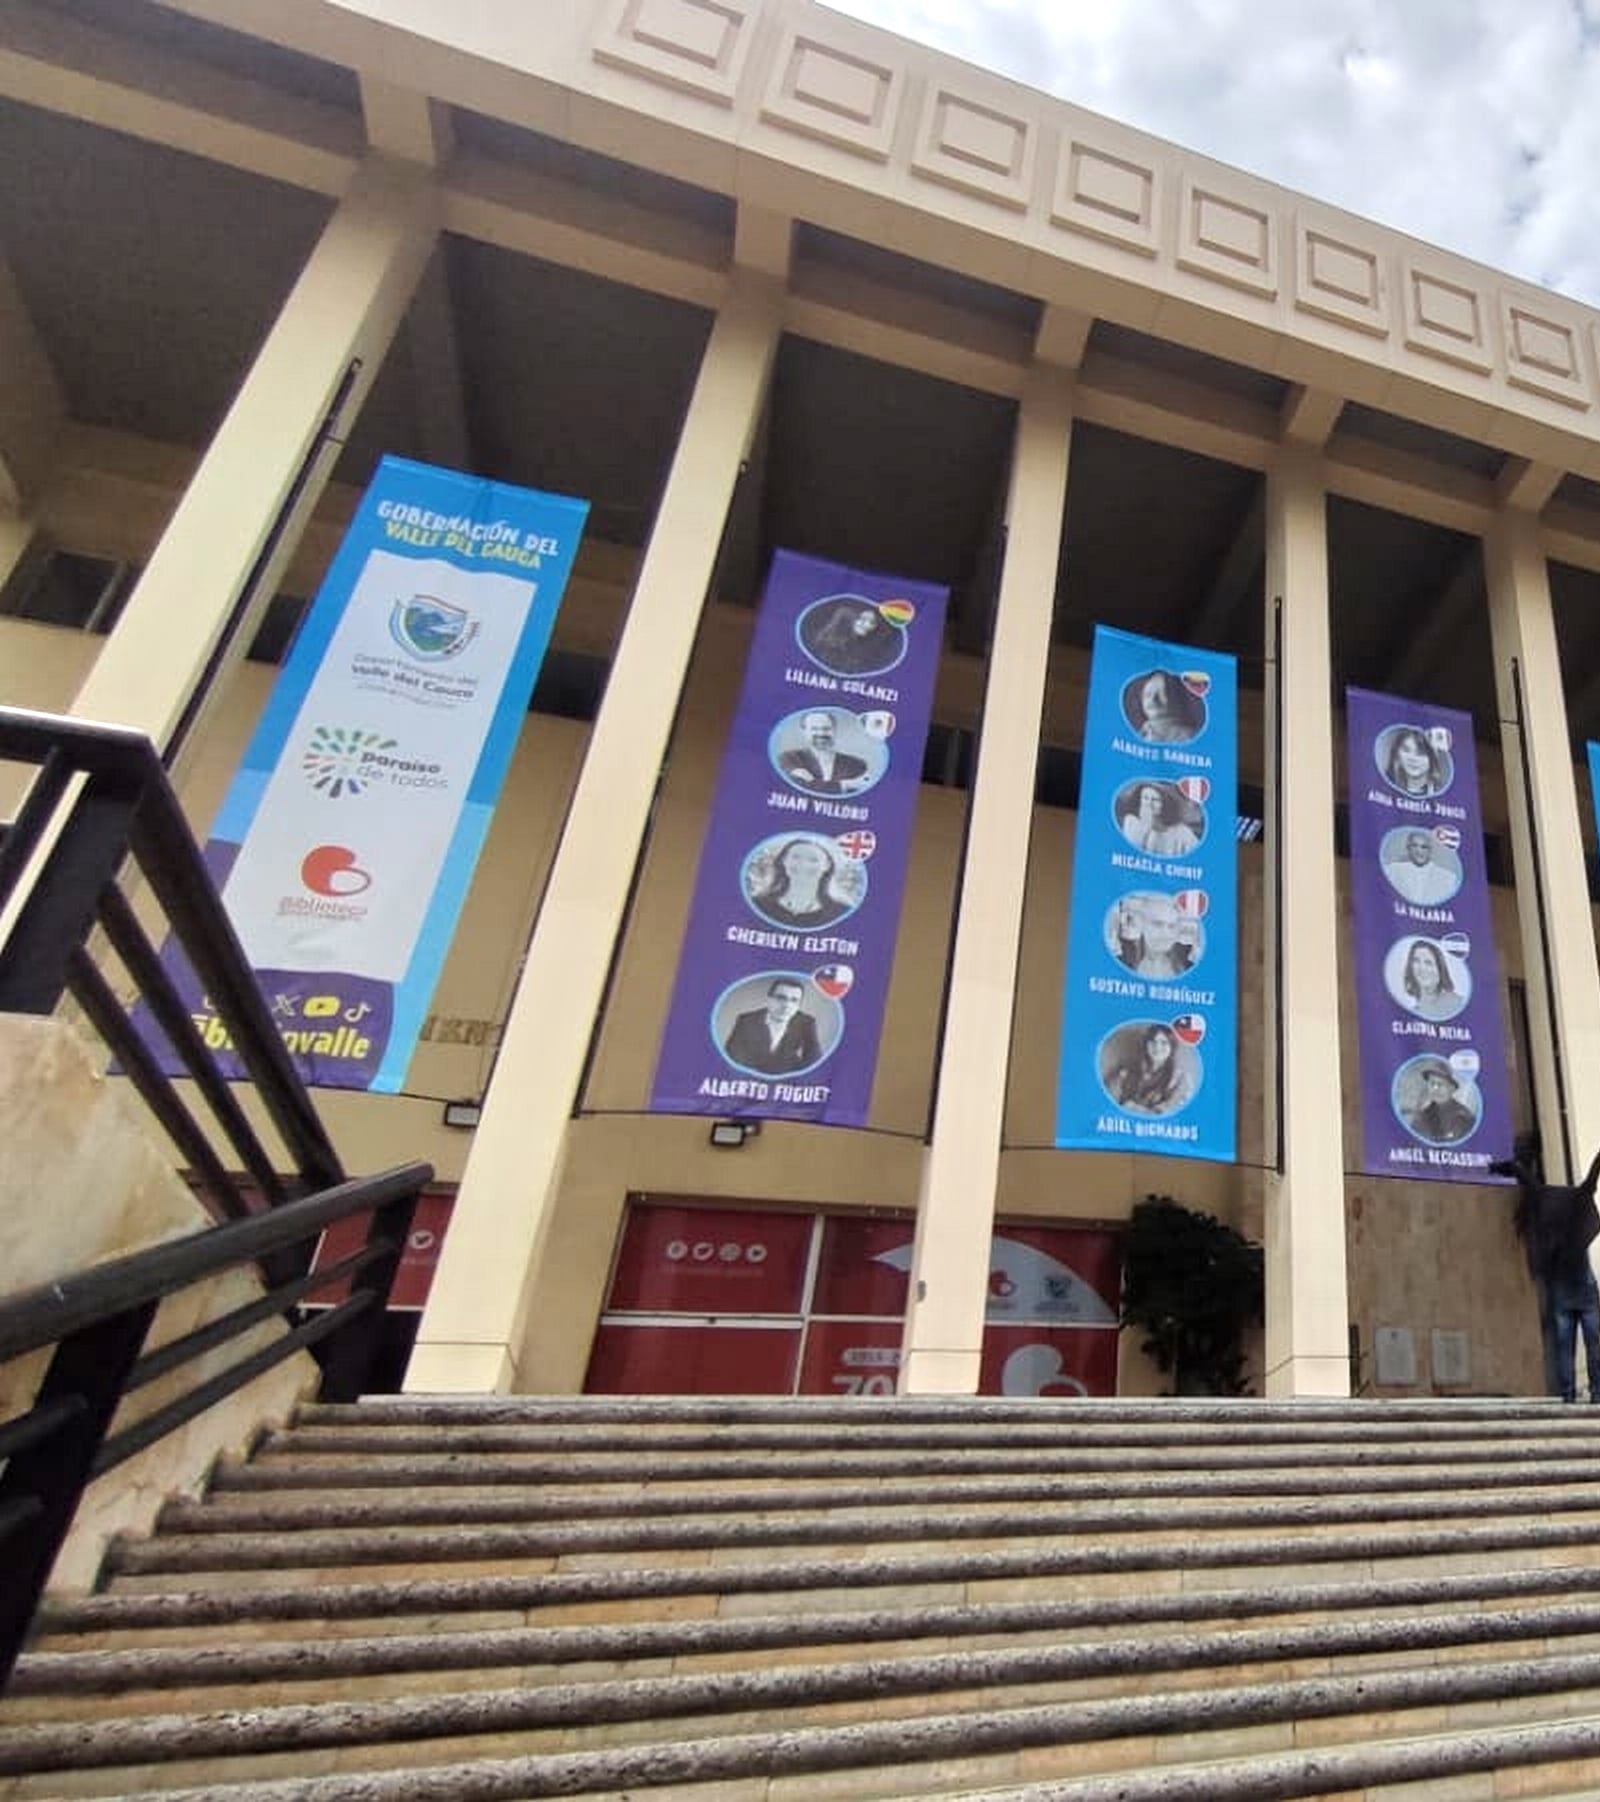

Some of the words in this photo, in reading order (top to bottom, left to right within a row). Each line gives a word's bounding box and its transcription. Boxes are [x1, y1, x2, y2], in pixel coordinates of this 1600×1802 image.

[377, 500, 520, 546] GOBERNACIÓN
[524, 533, 559, 557] DEL
[385, 521, 439, 547] VALLE
[444, 532, 476, 558] DEL
[480, 542, 542, 570] CAUCA
[785, 668, 837, 692] LILIANA
[841, 679, 899, 702] COLANZI
[767, 791, 808, 814] JUAN
[813, 801, 869, 822] VILLORO
[727, 925, 798, 950] CHERILYN
[803, 937, 859, 956] ELSTON
[1088, 977, 1146, 998] GUSTAVO
[1149, 985, 1216, 1006] RODRÍGUEZ
[699, 1077, 767, 1101] ALBERTO
[773, 1085, 831, 1103] FUGUET
[1097, 1115, 1133, 1135] ARIEL
[1134, 1122, 1199, 1141] RICHARDS
